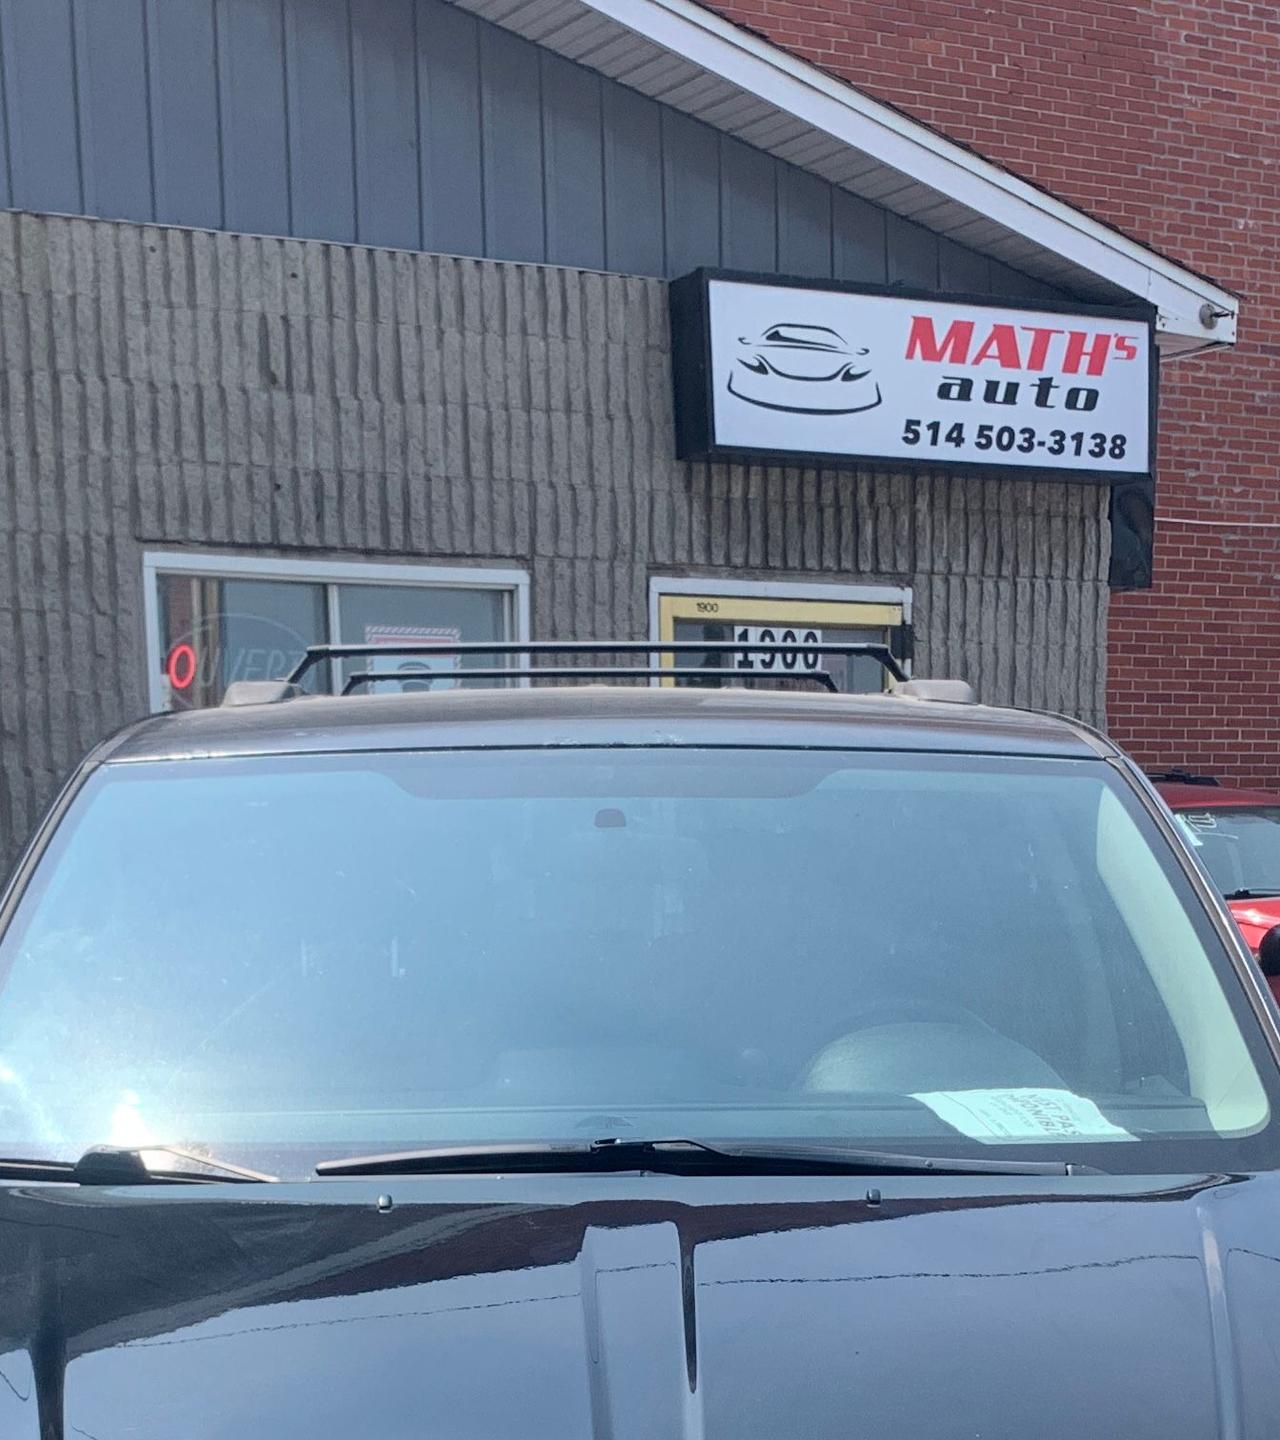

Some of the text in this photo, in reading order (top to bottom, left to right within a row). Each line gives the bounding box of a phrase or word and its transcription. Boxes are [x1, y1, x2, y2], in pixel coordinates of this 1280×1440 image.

[936, 376, 1101, 413] auto
[901, 419, 1128, 460] 514 503-3138
[696, 602, 720, 613] 1900
[737, 628, 820, 670] 1900
